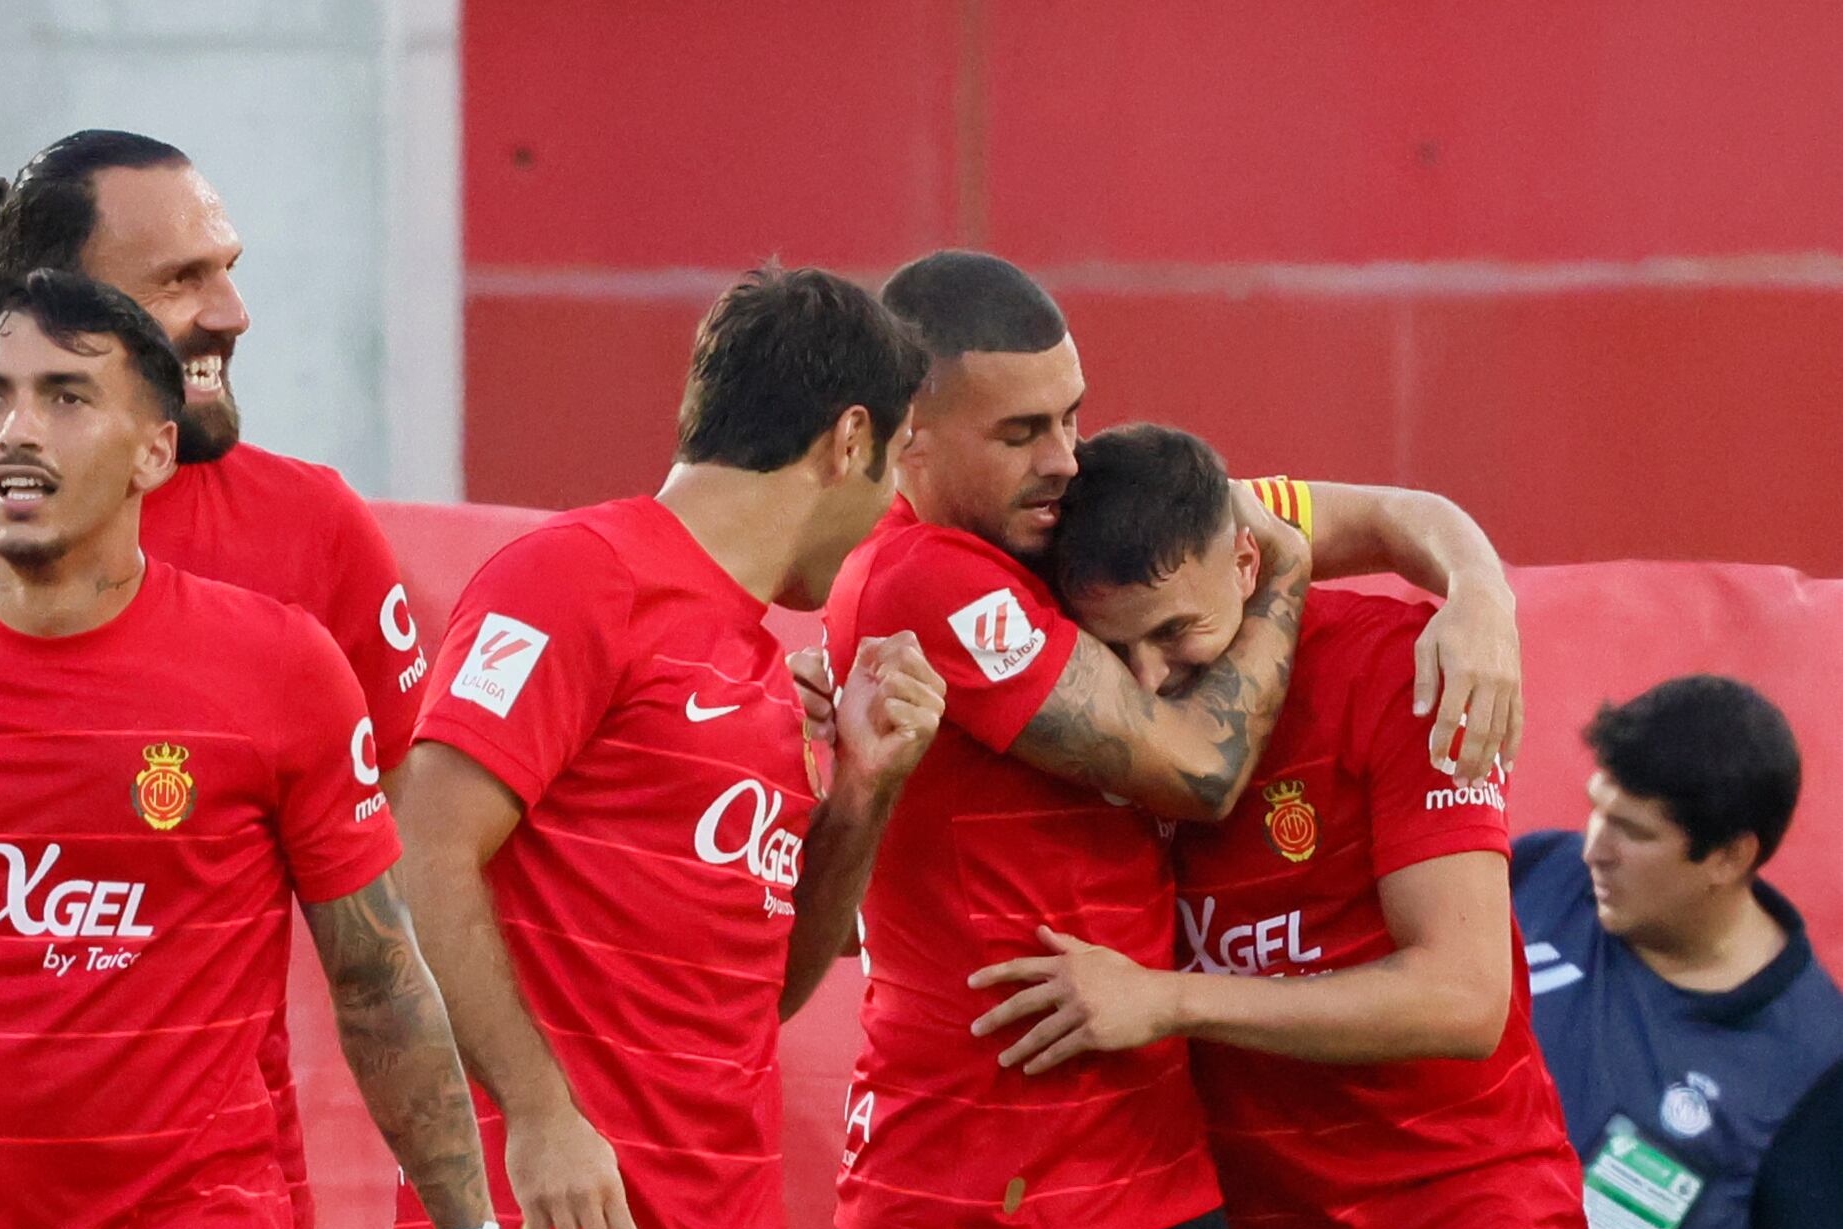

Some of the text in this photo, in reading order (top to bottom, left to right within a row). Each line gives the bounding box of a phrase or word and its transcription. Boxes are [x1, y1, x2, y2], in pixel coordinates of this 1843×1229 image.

[993, 637, 1039, 676] LALIGA
[461, 673, 506, 702] LALIGA
[355, 791, 387, 823] mo
[43, 944, 76, 977] by
